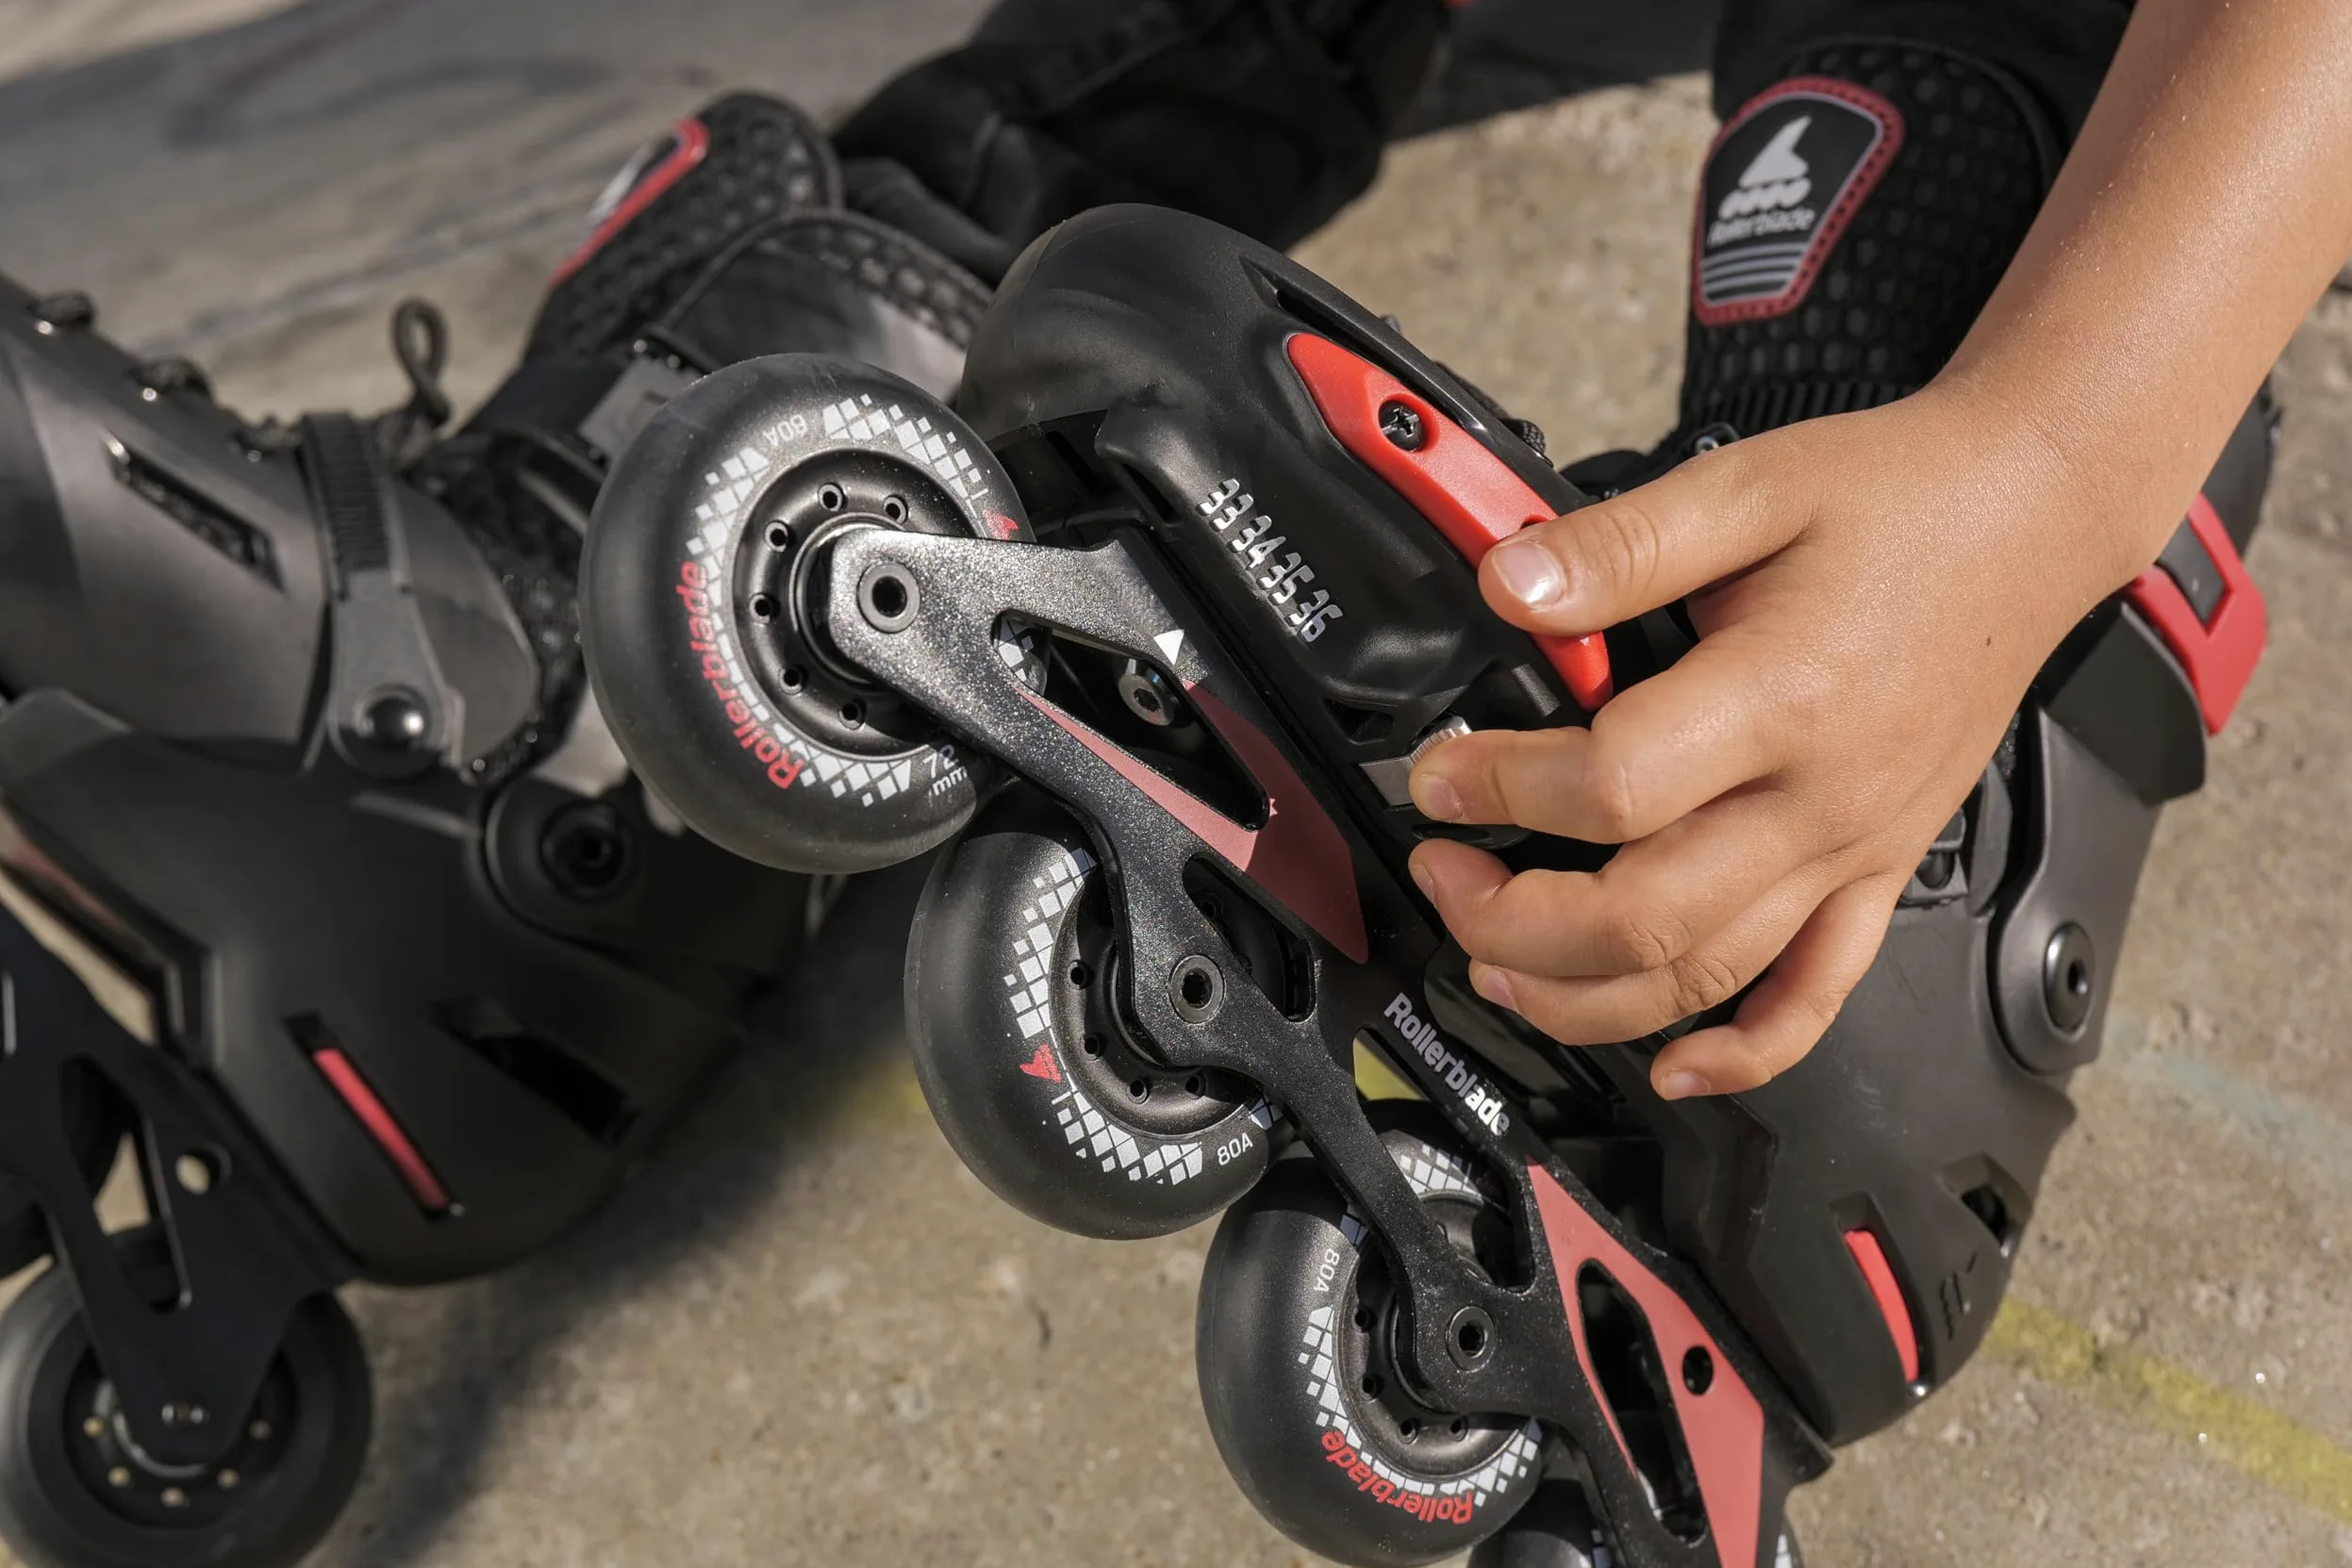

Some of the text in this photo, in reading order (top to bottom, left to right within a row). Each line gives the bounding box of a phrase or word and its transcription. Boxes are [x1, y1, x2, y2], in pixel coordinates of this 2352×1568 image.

[762, 413, 808, 447] 80A
[1198, 478, 1344, 642] 33 34 35 36
[675, 561, 804, 790] Rollerblade
[922, 744, 959, 780] 72
[932, 765, 968, 796] mm
[1383, 992, 1510, 1136] Rollerblade
[1217, 1132, 1254, 1166] 80A
[1313, 1247, 1341, 1294] 80A
[1320, 1428, 1474, 1525] Rollerblade
